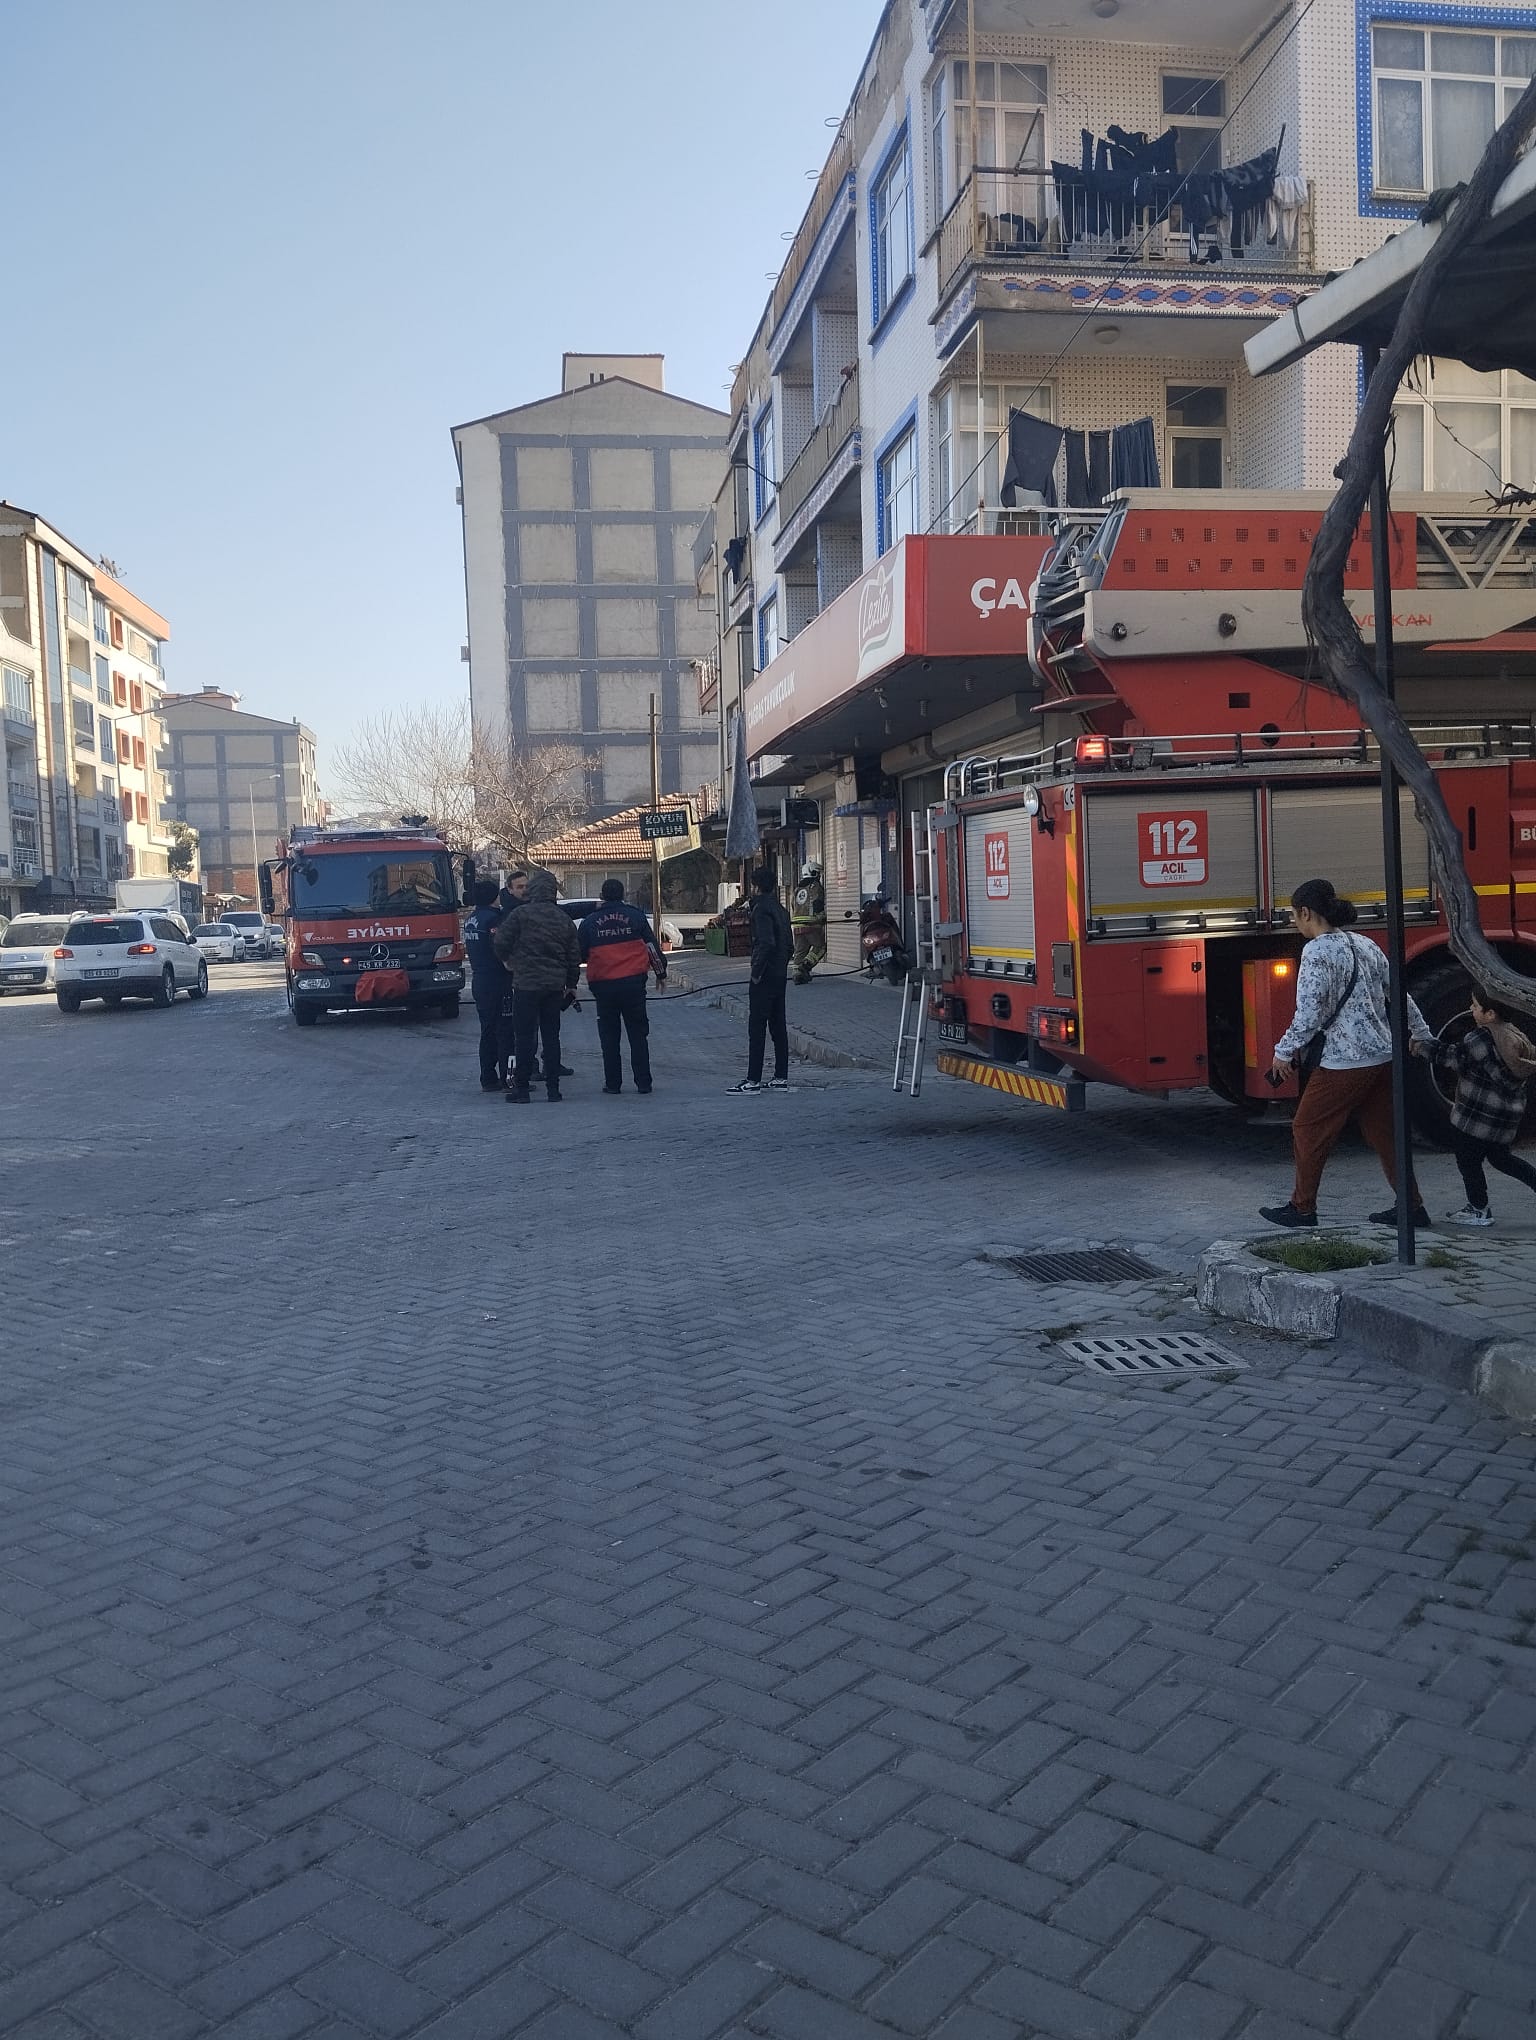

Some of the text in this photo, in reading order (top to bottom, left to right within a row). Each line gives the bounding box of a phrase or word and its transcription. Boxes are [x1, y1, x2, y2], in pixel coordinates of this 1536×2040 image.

[862, 582, 891, 639] Lezita
[971, 577, 1038, 618] ÇA
[988, 840, 1006, 871] 112
[1149, 819, 1198, 856] 112
[597, 926, 633, 938] İTFAİYE
